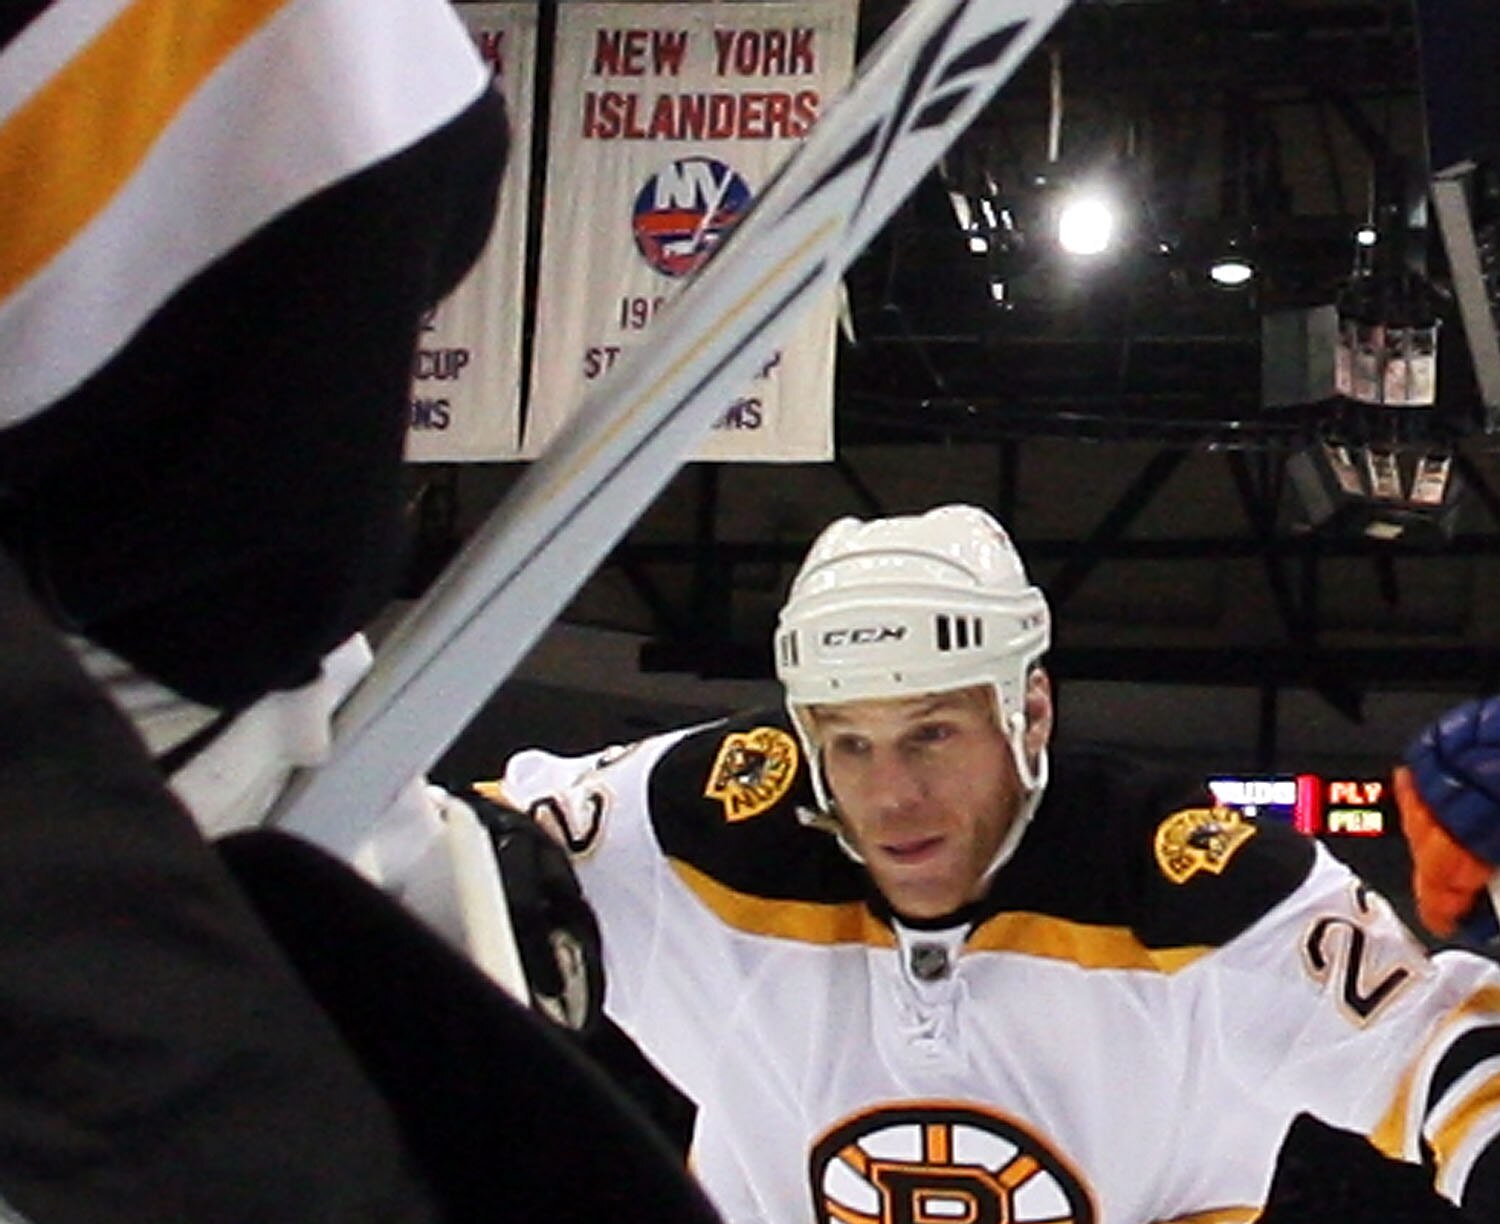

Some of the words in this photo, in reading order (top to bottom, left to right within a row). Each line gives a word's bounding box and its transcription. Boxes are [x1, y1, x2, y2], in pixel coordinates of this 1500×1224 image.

[594, 29, 687, 77] NEW
[714, 28, 816, 77] YORK
[583, 92, 821, 140] ISLANDERS
[821, 625, 909, 647] CCM
